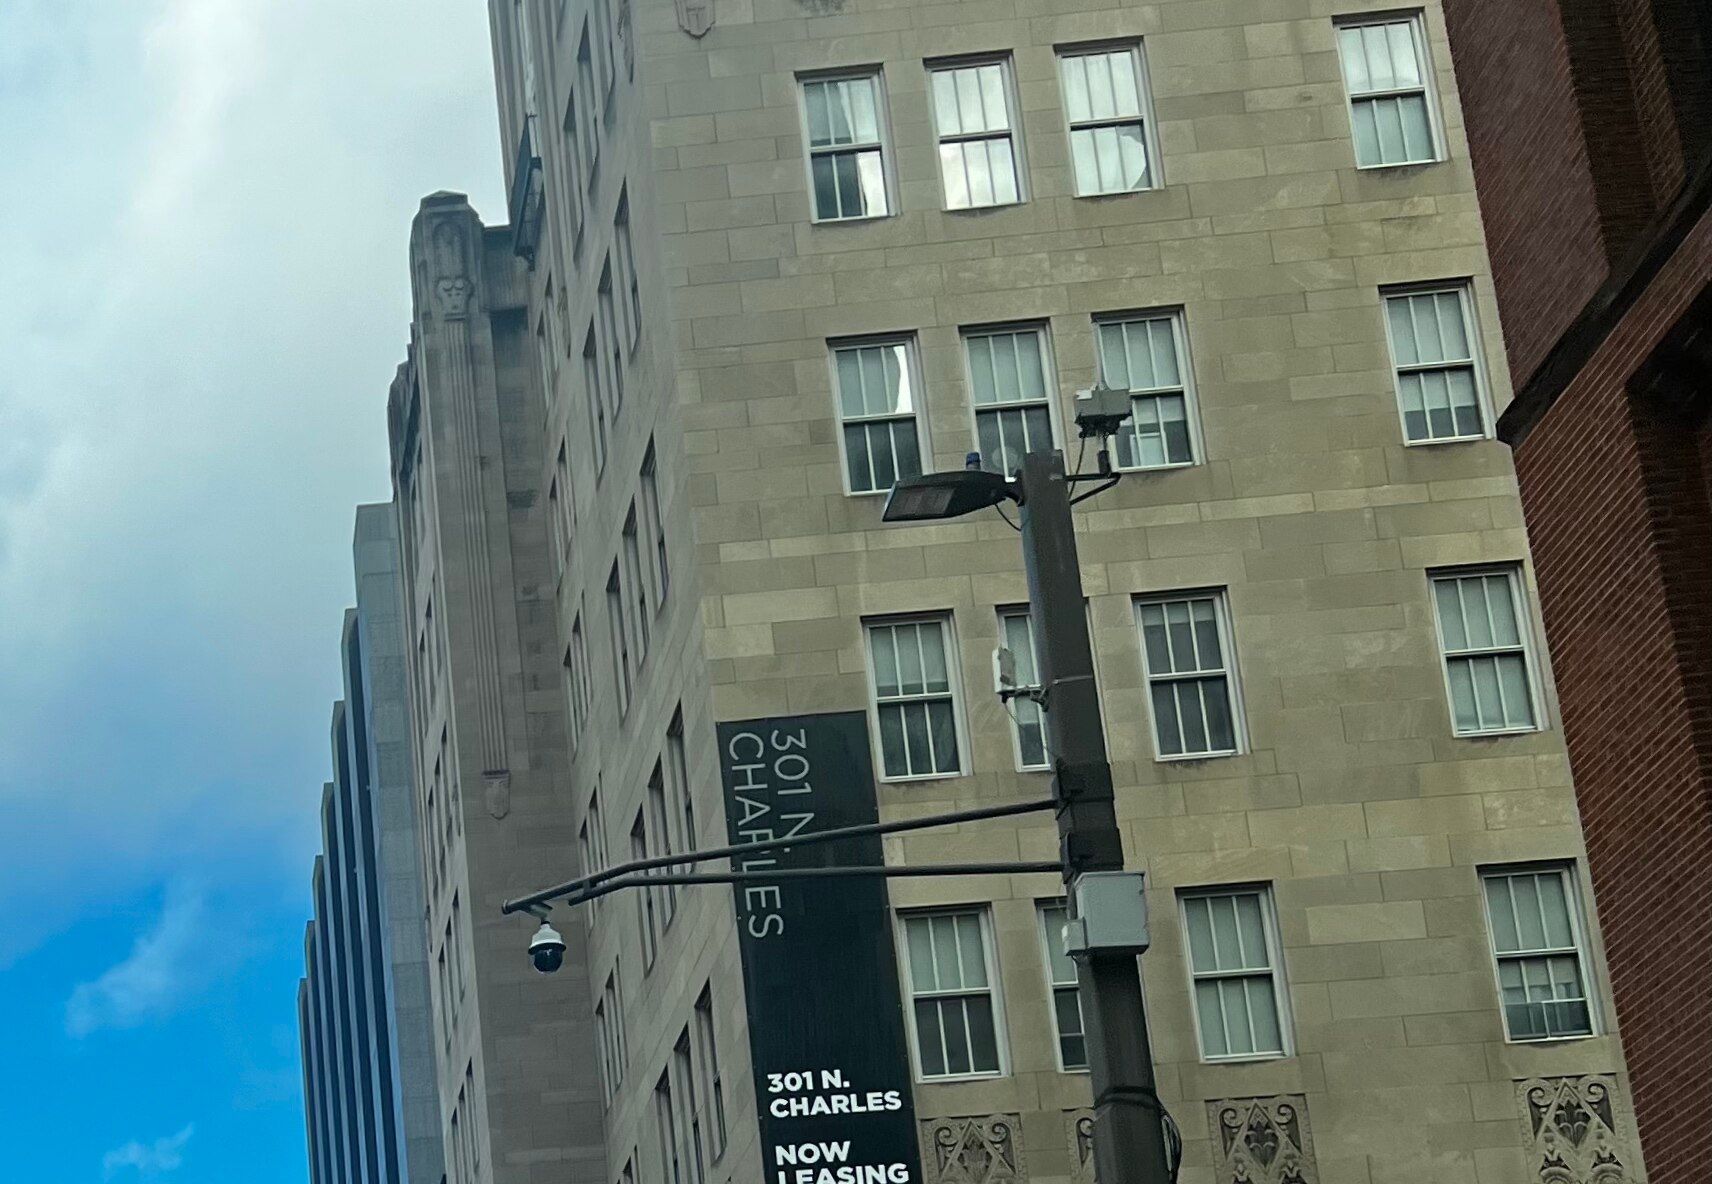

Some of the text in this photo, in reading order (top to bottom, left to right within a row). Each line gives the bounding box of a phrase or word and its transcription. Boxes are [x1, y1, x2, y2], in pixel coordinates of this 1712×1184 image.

[771, 728, 813, 795] 301
[767, 1068, 850, 1093] 301 N.
[770, 1090, 902, 1118] CHARLES
[775, 1140, 851, 1166] NOW
